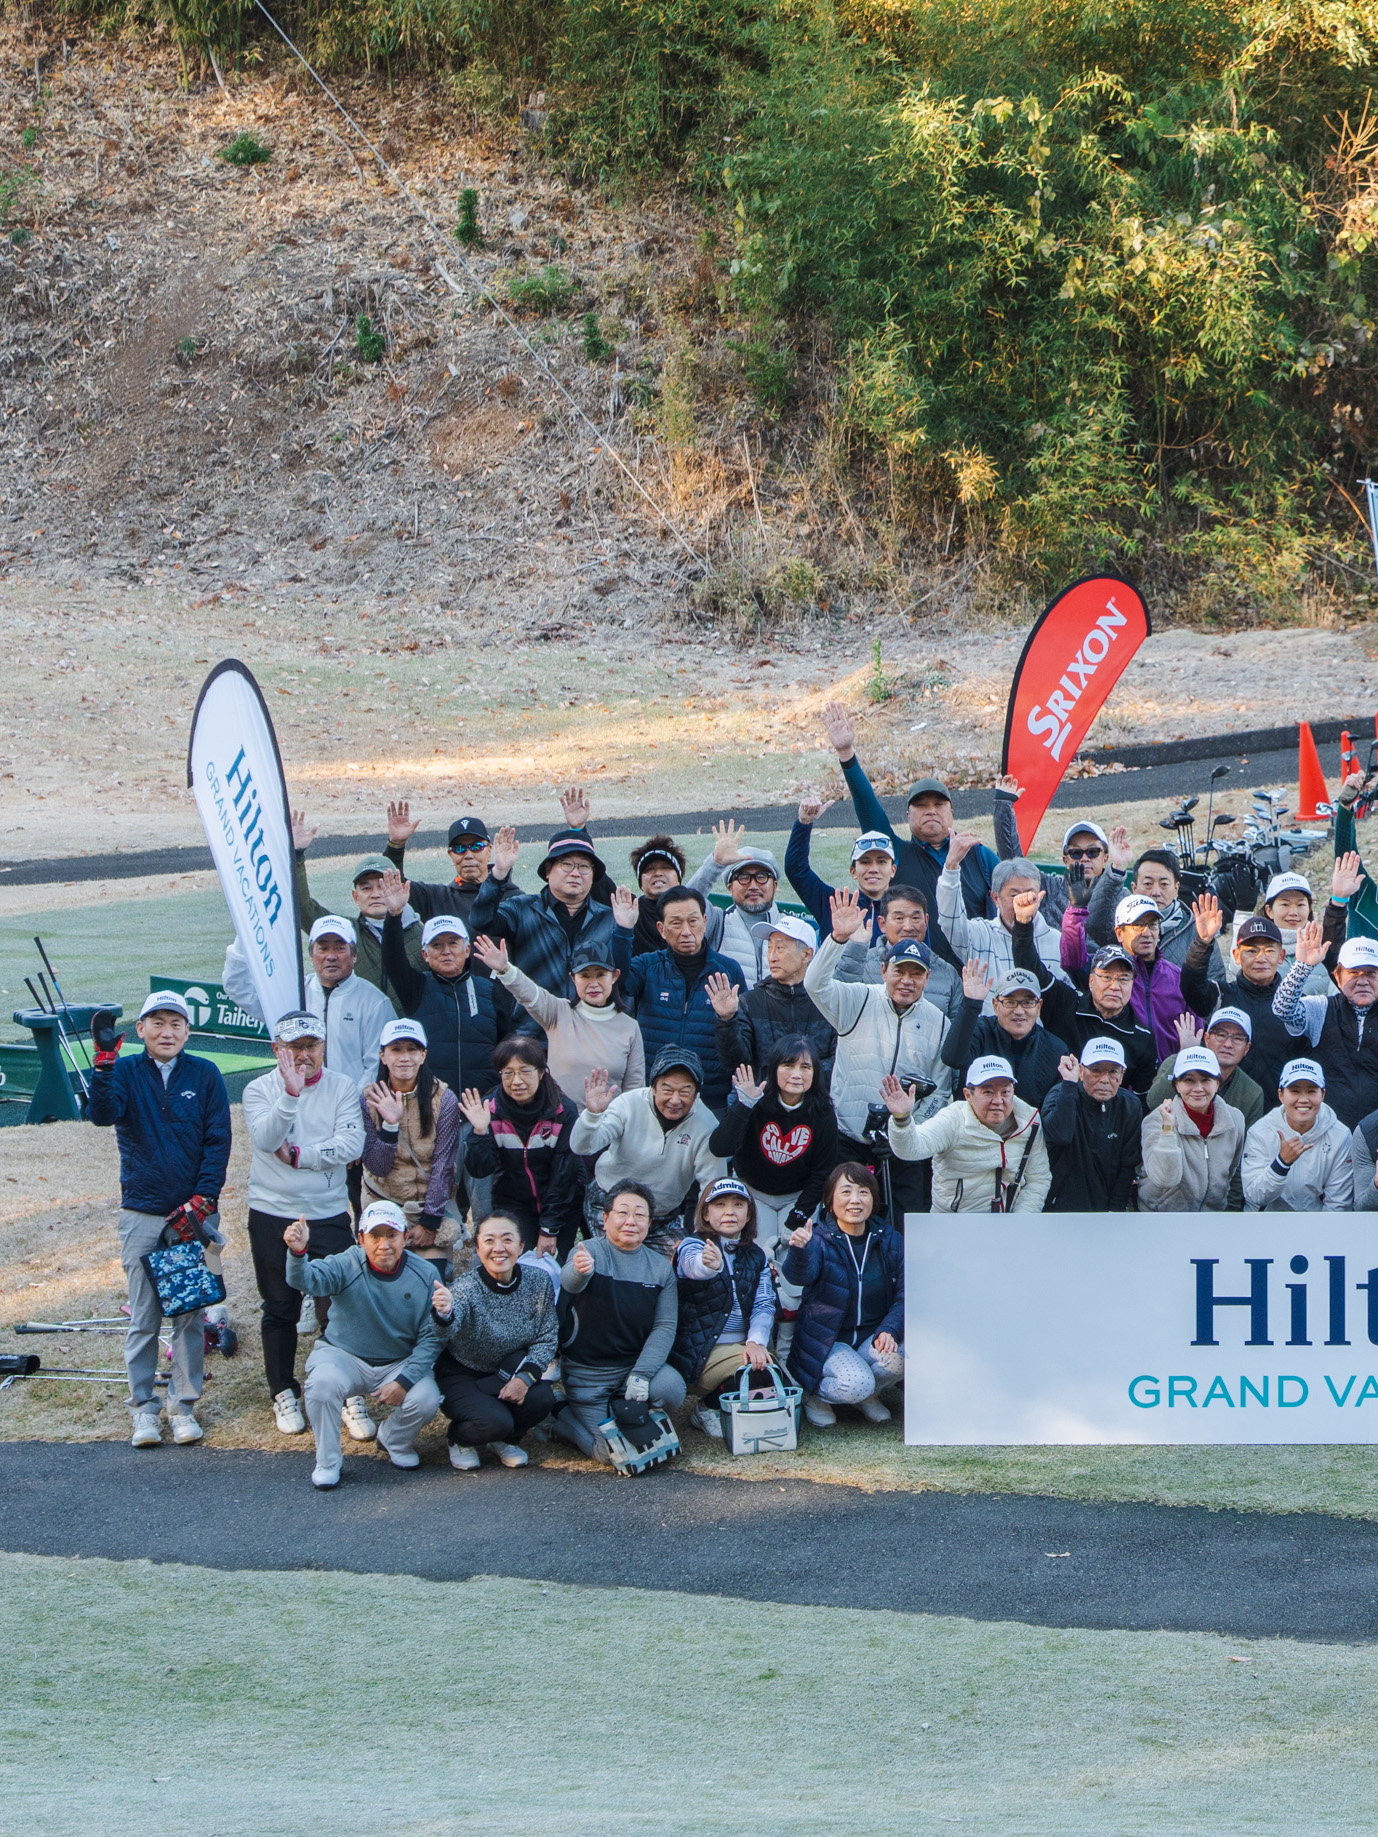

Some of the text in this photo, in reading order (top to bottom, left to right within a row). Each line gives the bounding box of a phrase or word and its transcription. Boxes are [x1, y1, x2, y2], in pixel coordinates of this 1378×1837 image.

[1027, 600, 1128, 763] SRIXON
[225, 744, 283, 930] Hilton
[206, 761, 276, 979] GRAND VACATIONS
[1006, 972, 1034, 983] Callaway
[394, 1024, 415, 1032] Hilton
[1095, 1043, 1116, 1053] Hilton
[982, 1061, 1004, 1070] Hilton
[1291, 1063, 1314, 1072] Hilton
[711, 1178, 746, 1192] Admiral
[1127, 1373, 1309, 1409] GRAND
